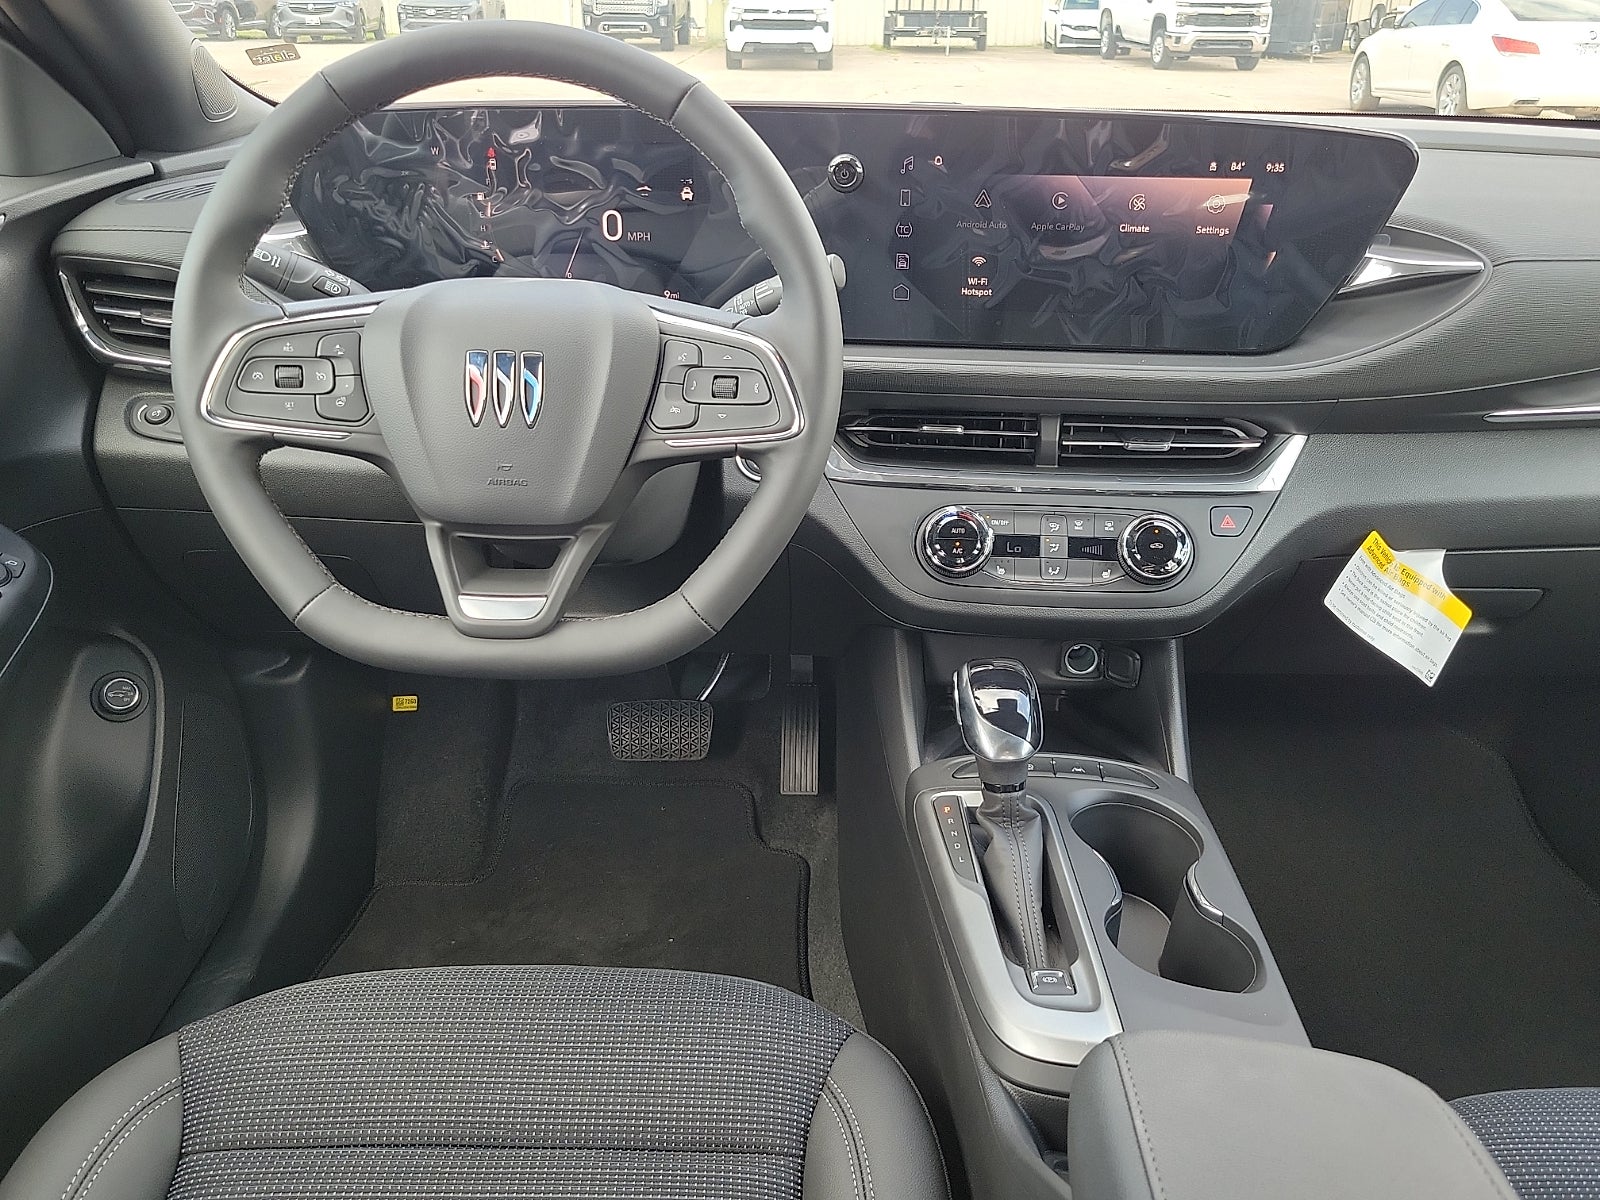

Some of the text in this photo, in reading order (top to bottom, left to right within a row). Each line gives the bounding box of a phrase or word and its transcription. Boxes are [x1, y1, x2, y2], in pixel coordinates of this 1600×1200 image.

[430, 146, 440, 155] W
[1265, 163, 1285, 173] 9:35
[602, 209, 651, 242] 0 MPH
[899, 225, 910, 235] TC
[956, 219, 1008, 230] Android Auto
[1030, 222, 1085, 232] Apple CarPlay
[1118, 222, 1151, 234] Climate
[1195, 225, 1230, 237] Settings
[967, 277, 989, 286] Wi-Fi
[961, 287, 993, 298] Hotspot
[487, 478, 528, 487] AIRBAG
[1006, 541, 1022, 553] Lo
[1372, 537, 1382, 550] This
[1400, 568, 1432, 591] Equipped
[1393, 573, 1411, 588] Bags
[954, 842, 961, 850] D
